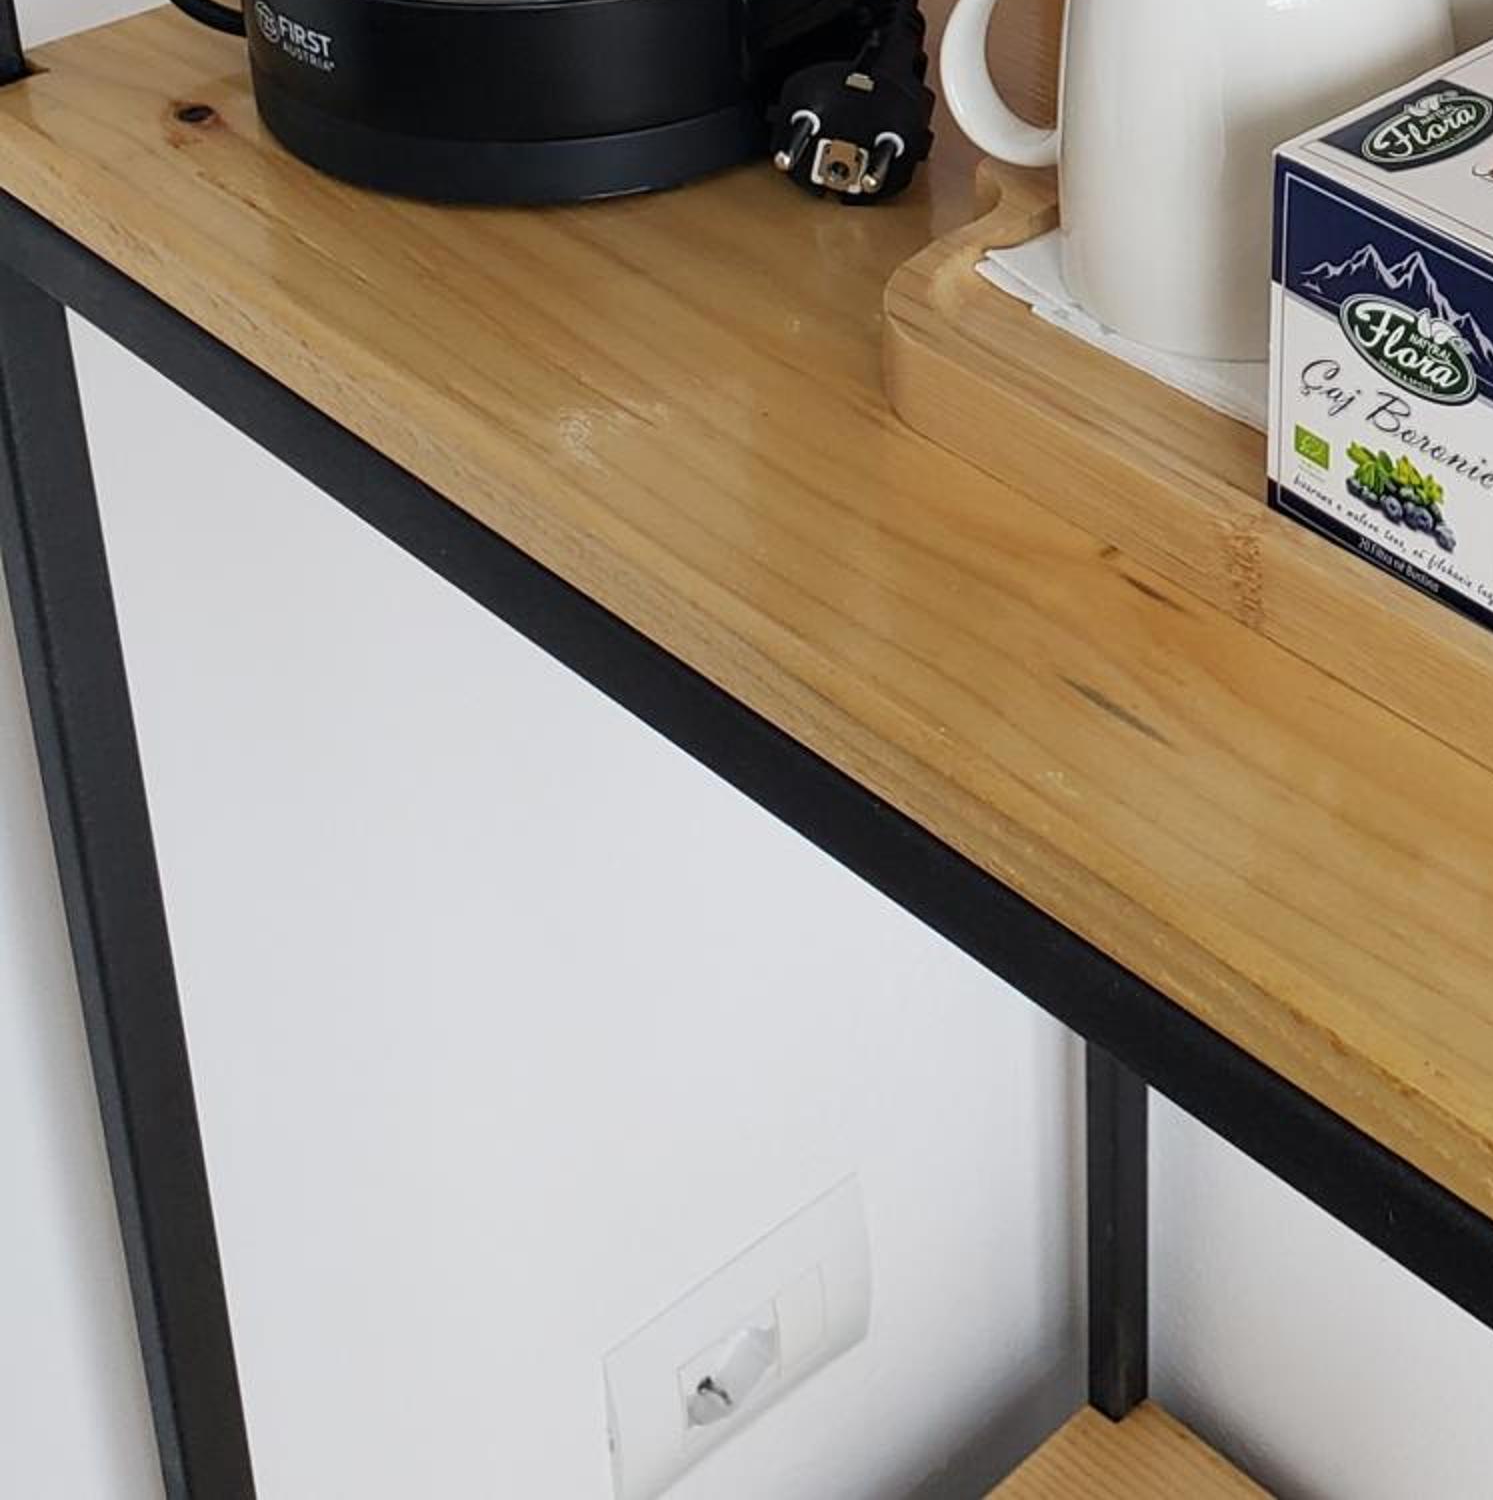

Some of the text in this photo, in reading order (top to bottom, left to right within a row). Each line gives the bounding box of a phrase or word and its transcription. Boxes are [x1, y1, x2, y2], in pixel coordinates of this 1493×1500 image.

[278, 14, 332, 58] FIRST
[1373, 104, 1477, 157] Flora
[1354, 301, 1462, 387] Flora
[1301, 359, 1361, 417] Çaj
